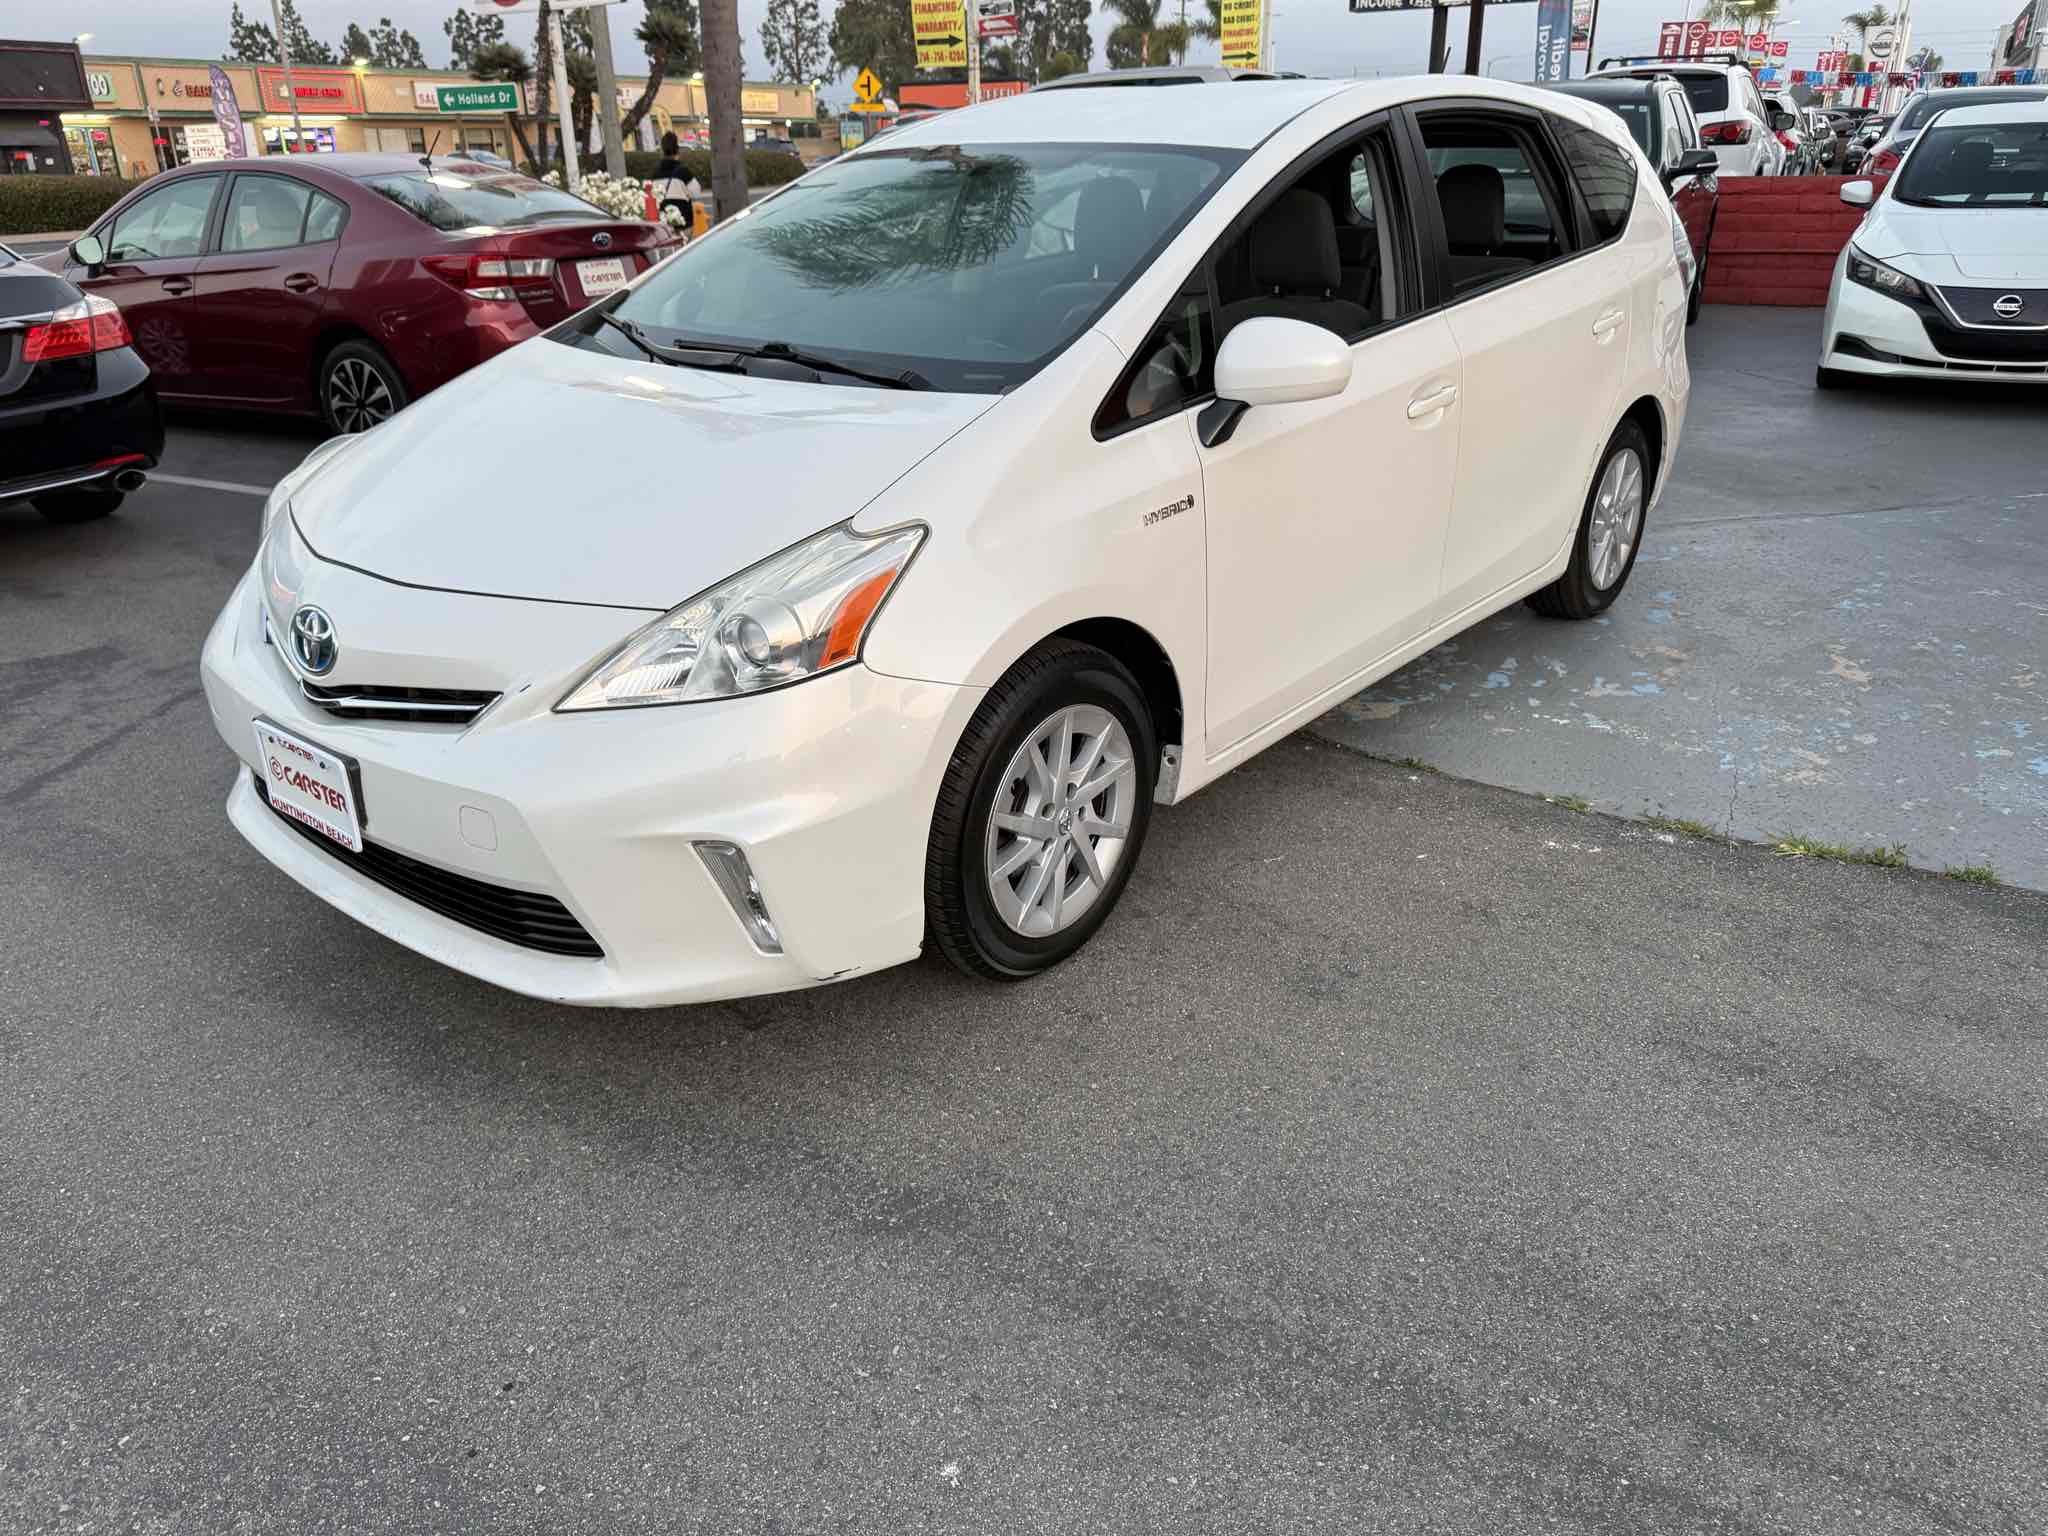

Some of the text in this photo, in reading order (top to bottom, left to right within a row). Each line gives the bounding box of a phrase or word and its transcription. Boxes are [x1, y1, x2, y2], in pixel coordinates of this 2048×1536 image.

[458, 93, 511, 104] Holland Dr
[284, 766, 349, 815] CARSTER
[271, 796, 354, 849] HUNTINGTON BEACH
